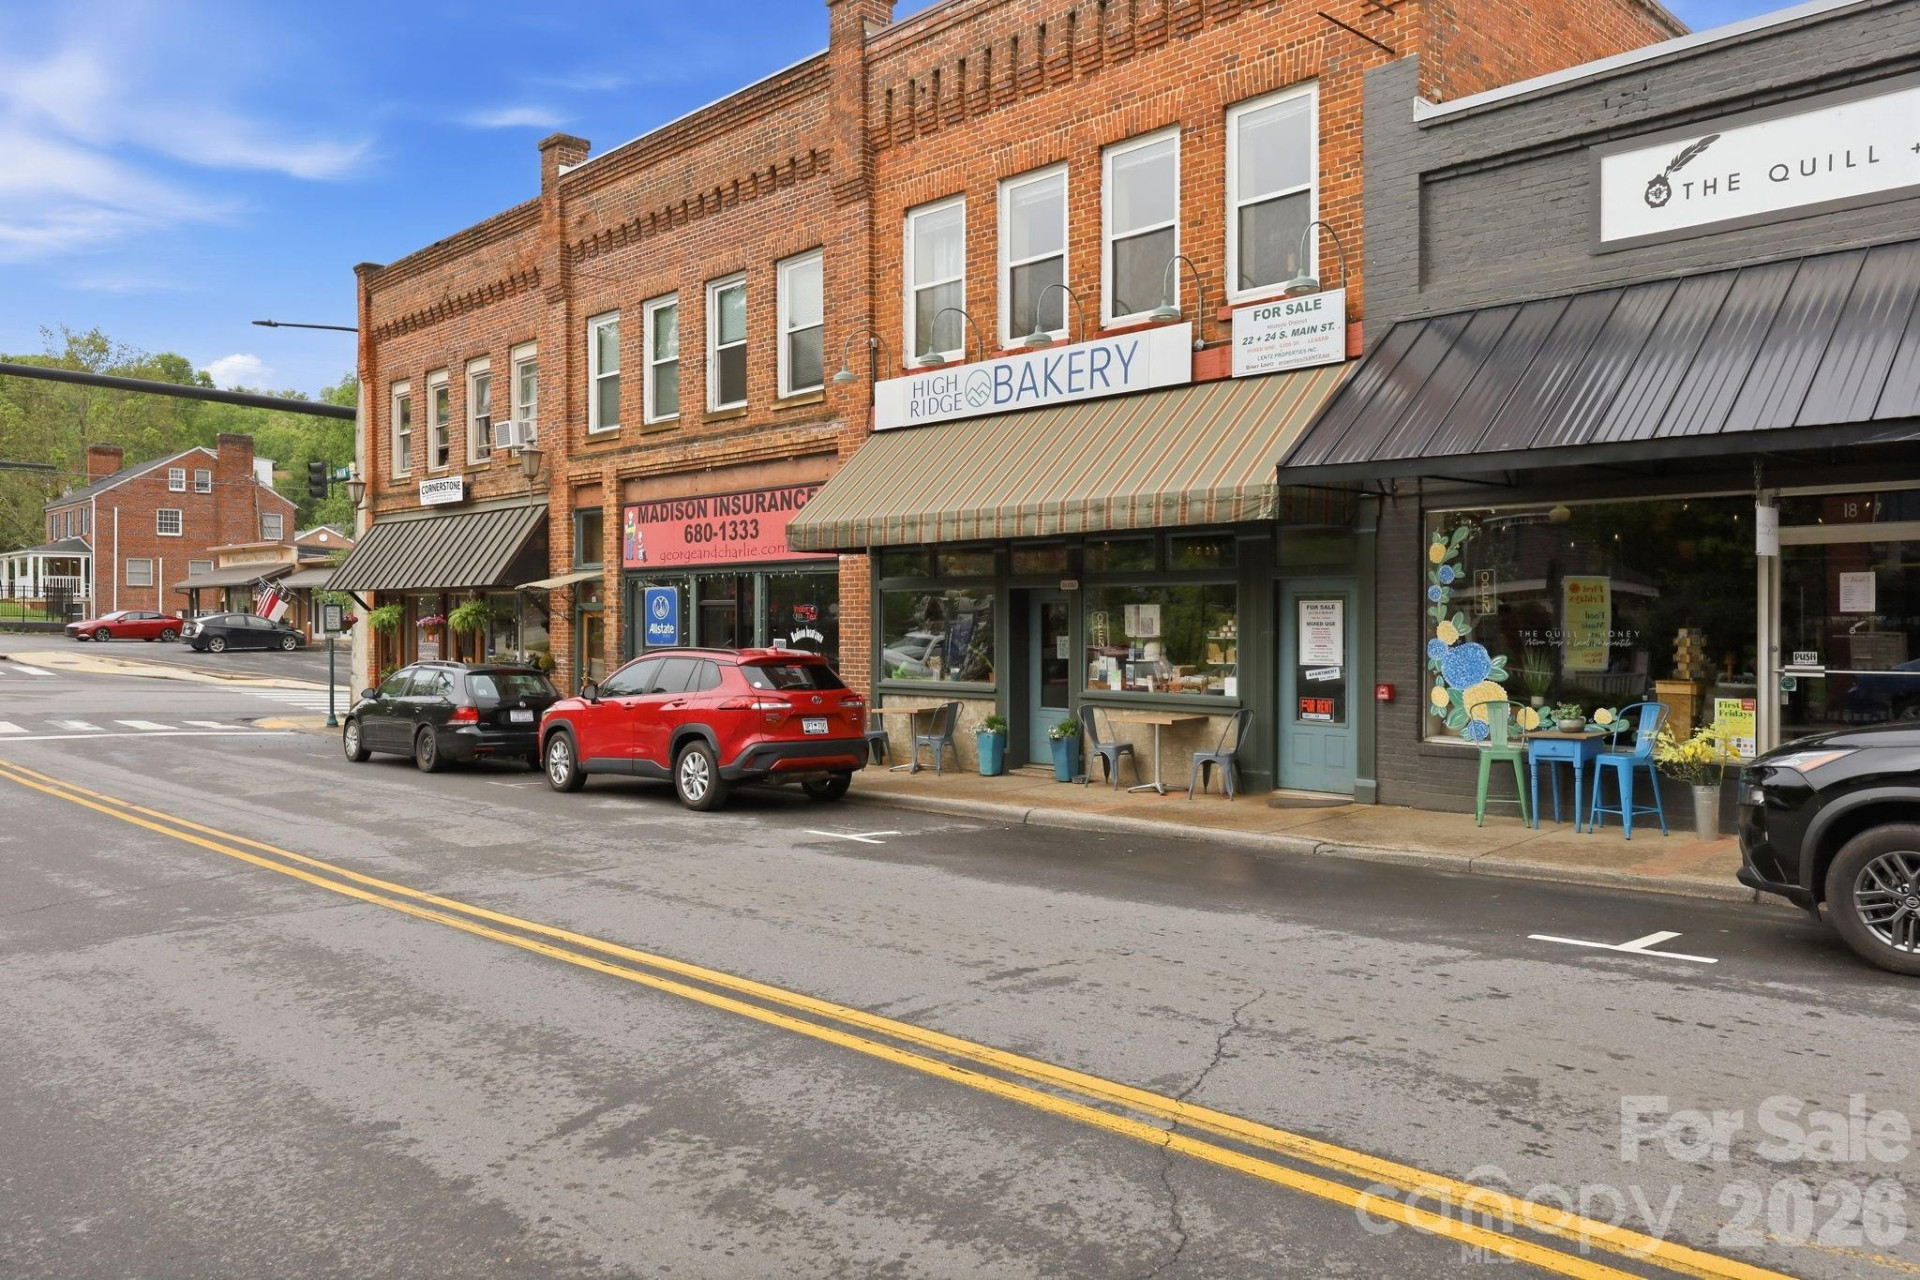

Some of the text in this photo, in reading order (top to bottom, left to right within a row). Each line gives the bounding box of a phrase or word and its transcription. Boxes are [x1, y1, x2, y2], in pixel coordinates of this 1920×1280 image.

[1682, 172, 1741, 200] THE
[1768, 145, 1880, 183] QUILL
[1253, 298, 1322, 321] FOR SALE
[1241, 337, 1254, 346] 22
[1264, 332, 1276, 342] 24
[1279, 330, 1288, 340] S.
[1290, 325, 1318, 337] MAIN
[1320, 322, 1335, 331] ST.
[993, 340, 1140, 405] BAKERY
[913, 373, 959, 400] HIGH
[910, 391, 963, 419] RIDGE
[421, 480, 461, 495] CORNERSTONE
[637, 499, 709, 525] MADISON
[1843, 502, 1858, 519] 18
[684, 518, 760, 545] 680-1333
[1480, 571, 1491, 614] OPEN
[648, 622, 675, 635] Allstate
[1097, 613, 1105, 648] OPEN
[1519, 630, 1538, 638] THE
[1794, 652, 1817, 661] PUSH
[1719, 700, 1741, 709] First
[1719, 709, 1753, 719] Fridays
